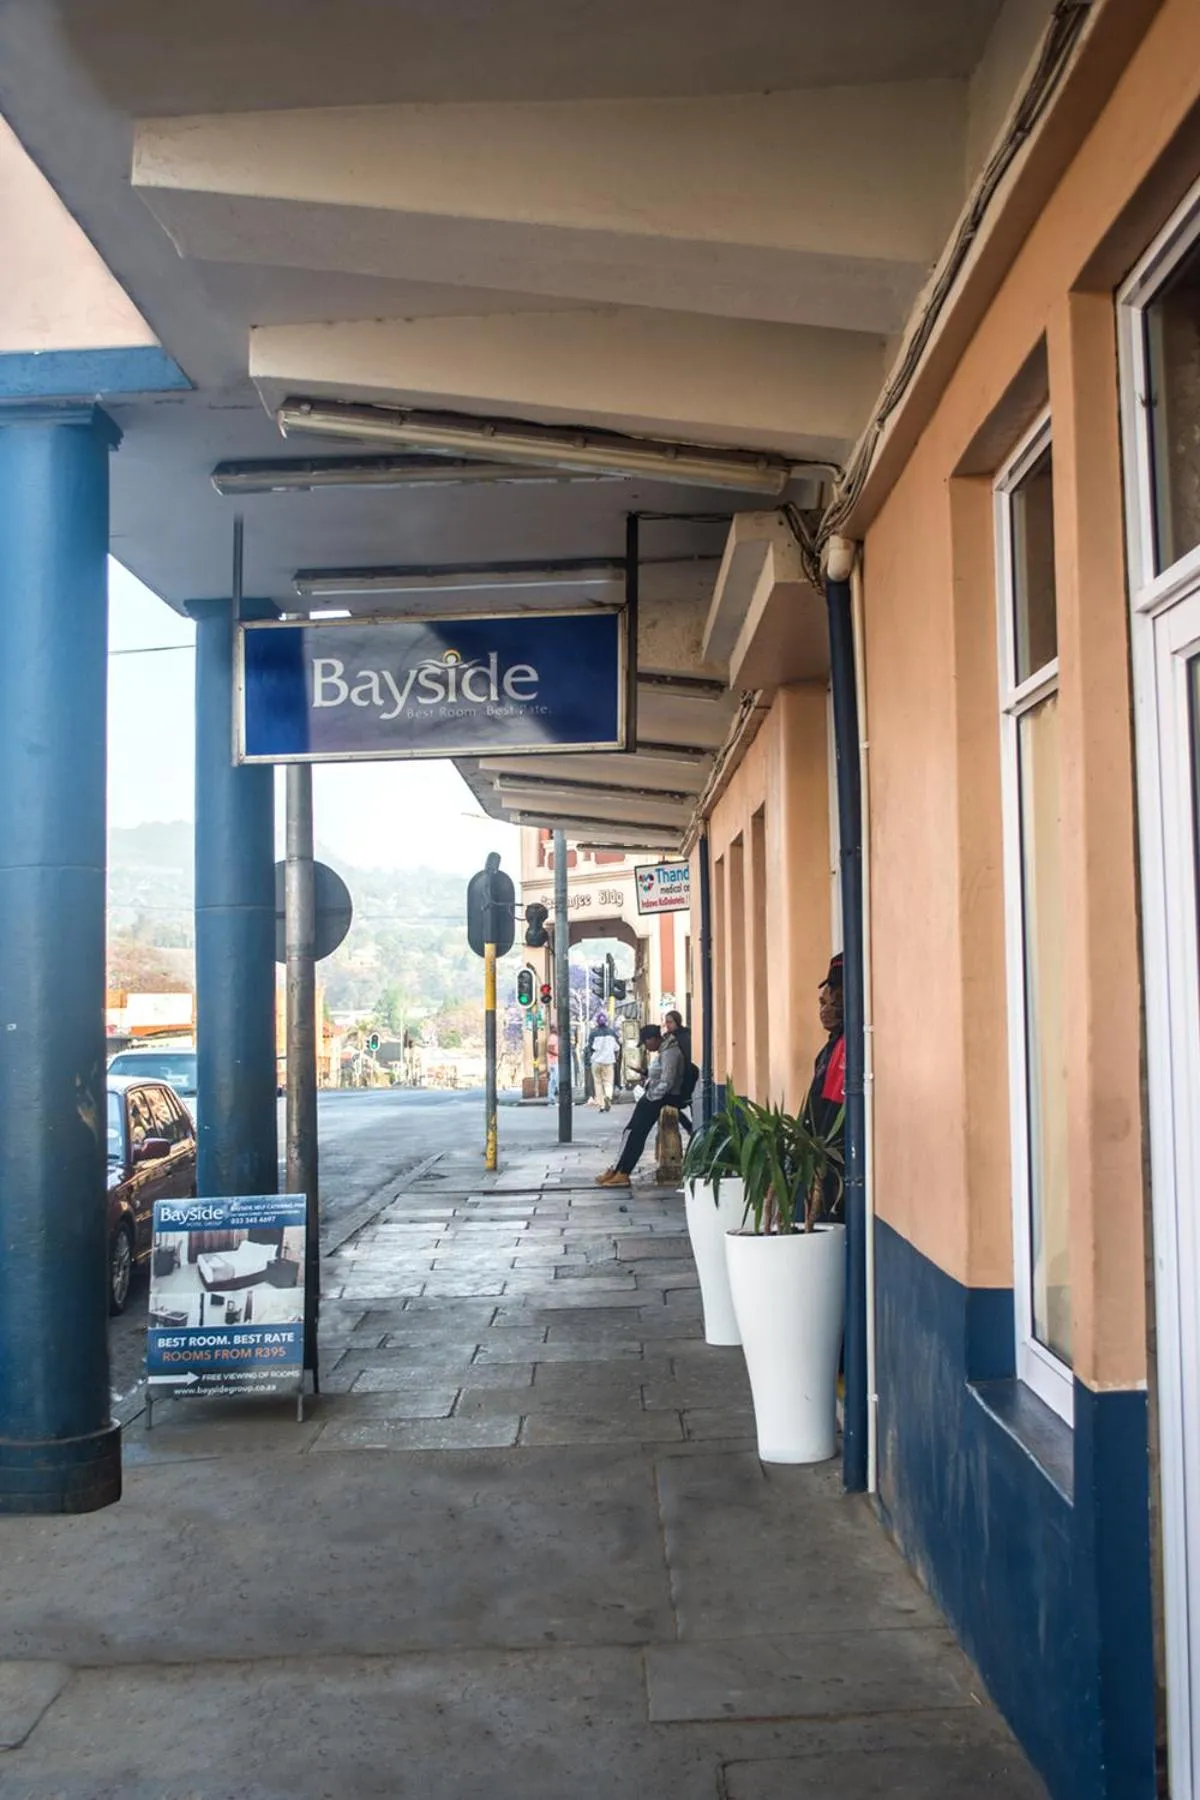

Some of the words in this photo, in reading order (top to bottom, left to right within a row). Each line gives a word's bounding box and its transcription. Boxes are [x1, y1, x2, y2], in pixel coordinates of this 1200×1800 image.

[312, 650, 539, 719] Bayside
[407, 707, 434, 719] Best
[486, 704, 514, 716] Best
[660, 885, 682, 895] medical
[160, 1205, 223, 1225] Bayside
[157, 1337, 186, 1348] BEST
[188, 1336, 231, 1347] ROOM.
[233, 1334, 262, 1345] BEST
[264, 1332, 295, 1343] RATE
[162, 1350, 211, 1361] ROOMS
[214, 1349, 252, 1360] FROM
[255, 1346, 287, 1358] R395
[202, 1373, 222, 1381] FREE
[222, 1372, 257, 1380] VIEWING
[257, 1371, 269, 1379] OF
[270, 1370, 300, 1378] ROOMS
[173, 1384, 277, 1396] www.baysidegroup.co.za
